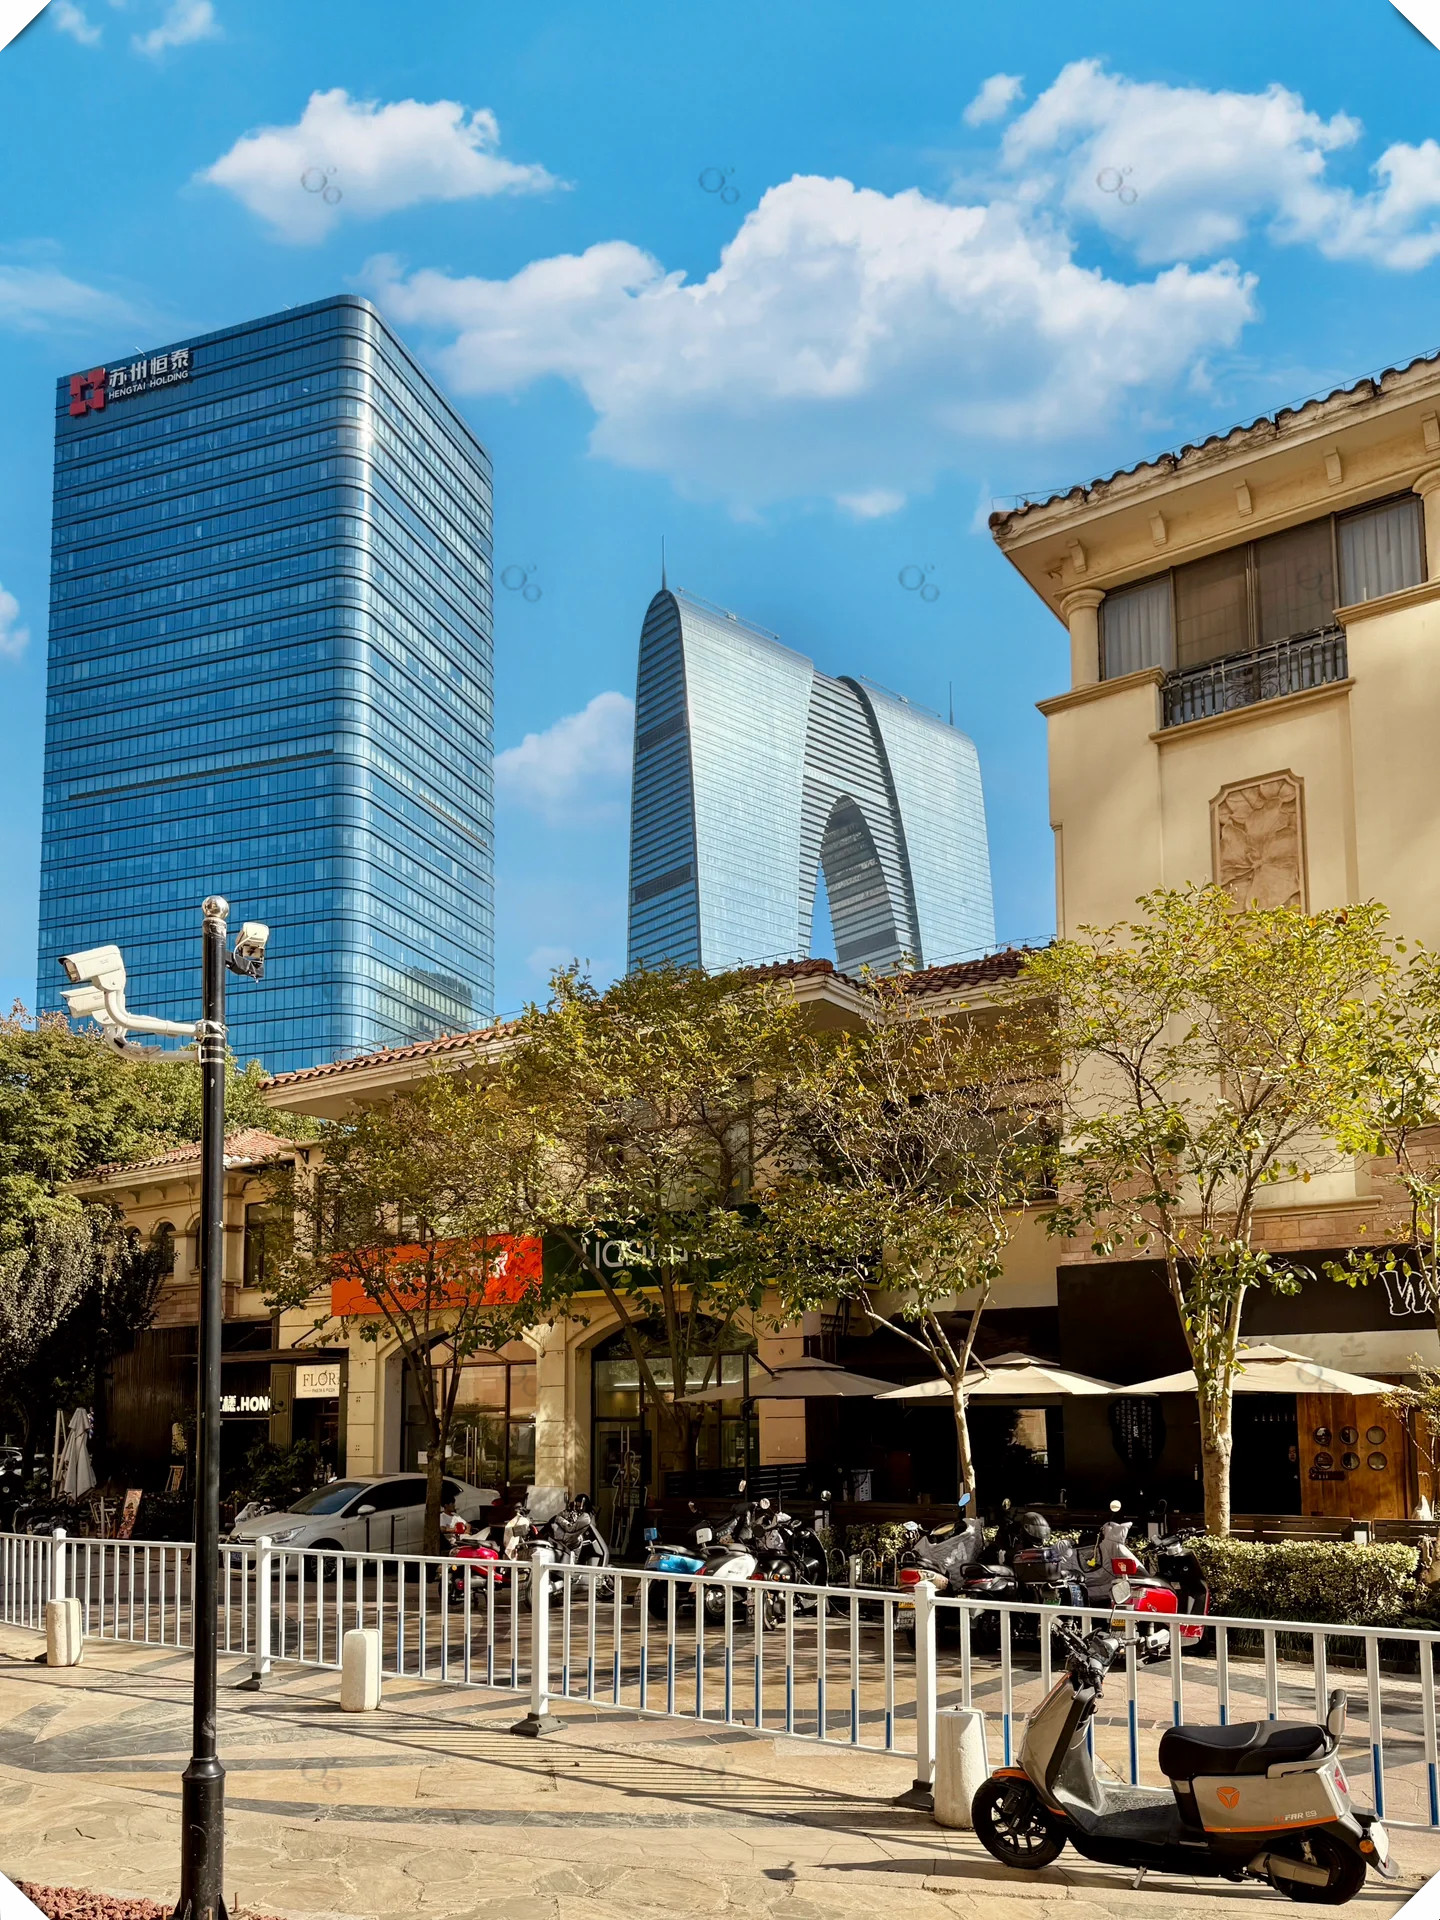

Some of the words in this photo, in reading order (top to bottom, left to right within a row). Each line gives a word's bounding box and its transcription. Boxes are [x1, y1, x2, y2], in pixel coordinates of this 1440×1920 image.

[109, 347, 189, 387] 苏州恒泰
[108, 384, 146, 400] HENGTAI
[149, 370, 188, 388] HOLDING
